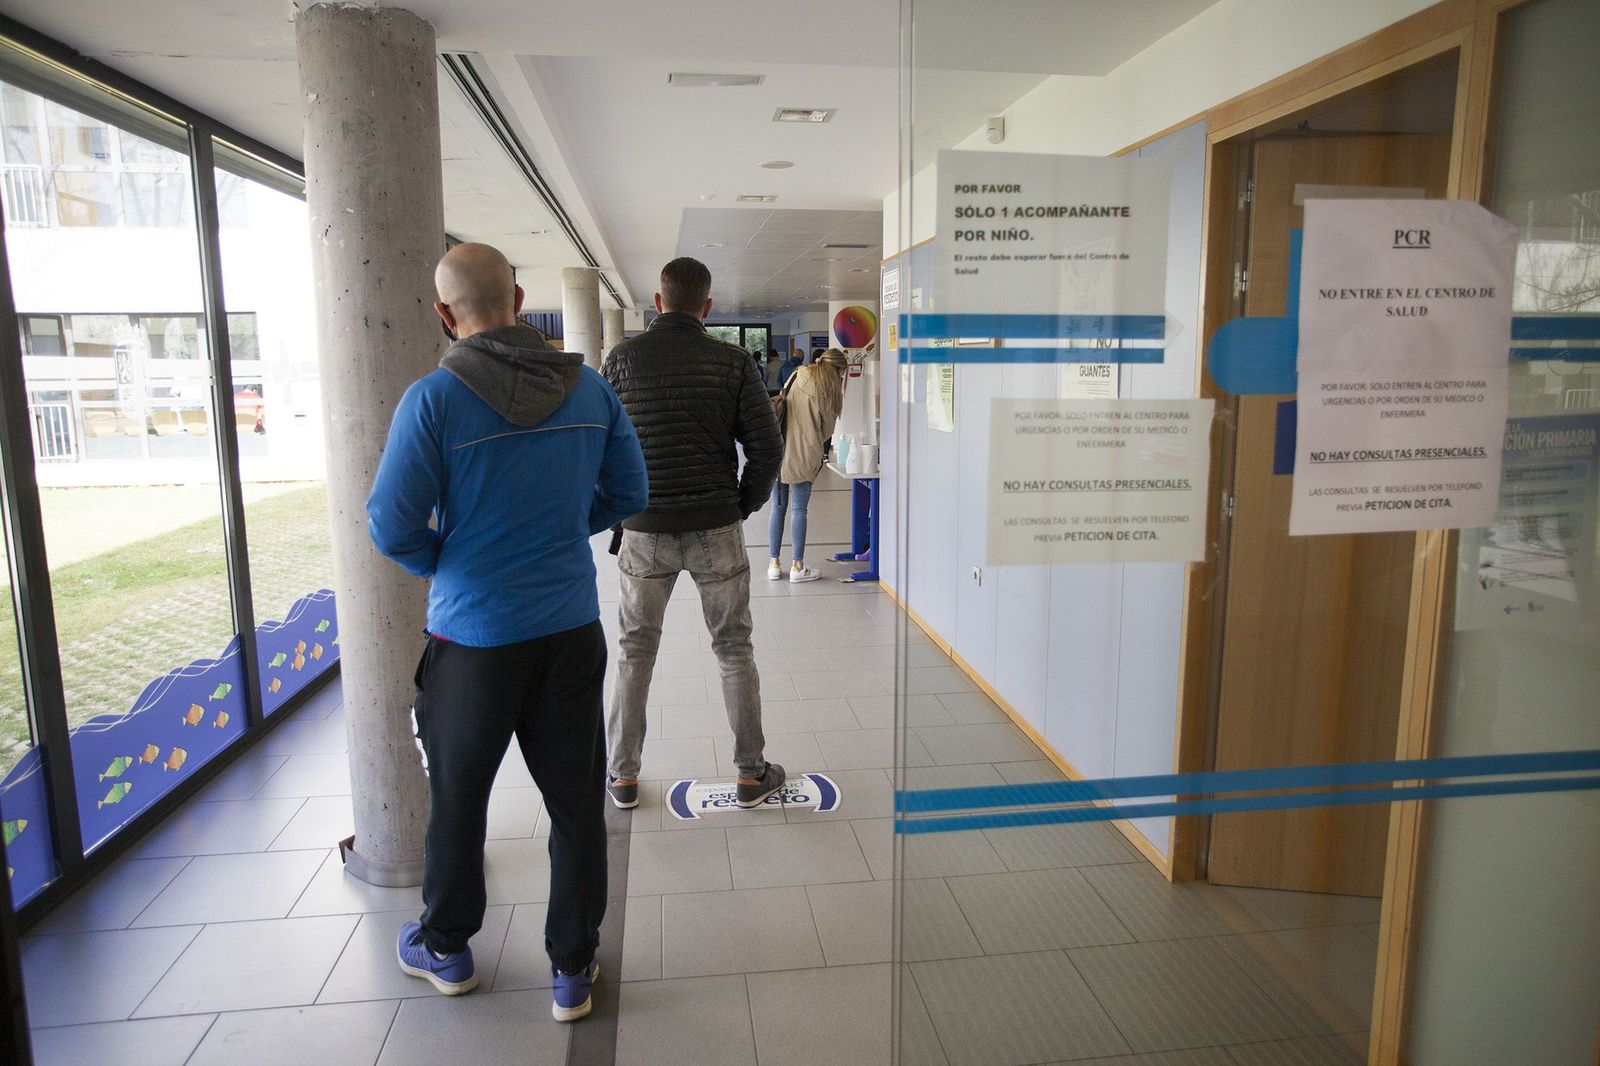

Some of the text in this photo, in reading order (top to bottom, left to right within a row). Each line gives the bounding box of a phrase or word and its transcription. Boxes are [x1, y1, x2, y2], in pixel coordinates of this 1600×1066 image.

[955, 185, 1021, 193] POR FAVOR
[955, 204, 1130, 218] SÓLO 1 ACOMPAÑANTE
[955, 228, 1034, 242] POR NIÑO.
[1394, 230, 1430, 246] PCR
[990, 253, 1011, 261] debe
[1014, 254, 1046, 263] esperar
[1119, 252, 1130, 260] de
[1318, 288, 1495, 299] NO ENTRE EN EL CENTRO DE
[1386, 306, 1428, 317] SALUD
[1079, 365, 1110, 377] GUANTES
[1321, 383, 1337, 391] POR
[1370, 382, 1390, 390] SOLO
[1392, 382, 1420, 390] ENTREN
[1434, 381, 1464, 389] CENTRO
[1466, 381, 1486, 389] PARA
[1322, 397, 1366, 406] URGENCIAS
[1368, 397, 1374, 405] O
[1376, 396, 1392, 404] POR
[1394, 396, 1420, 404] ORDEN
[1434, 395, 1443, 403] SU
[1445, 395, 1475, 403] MEDICO
[1380, 410, 1425, 419] ENFERMERA
[1015, 426, 1062, 434] URGENCIAS
[1063, 426, 1070, 434] O
[1072, 426, 1089, 434] POR
[1091, 426, 1120, 434] ORDEN
[1122, 426, 1132, 434] DE
[1134, 426, 1145, 434] SU
[1147, 426, 1179, 434] MEDICO
[1077, 440, 1126, 448] ENFERMERA
[1538, 429, 1596, 448] PRIMARIA
[1310, 447, 1487, 461] NO HAY CONSULTAS PRESENCIALES.
[1004, 479, 1191, 490] NO HAY CONSULTAS PRESENCIALES.
[1309, 483, 1481, 496] LAS CONSULTAS SE RESUELVEN POR TELEFONO
[1337, 499, 1452, 511] PREVIA PETICION DE CITA.
[1004, 518, 1019, 526] LAS
[1020, 517, 1066, 525] CONSULTAS
[1084, 516, 1129, 524] RESUELVEN
[1034, 531, 1159, 542] PREVIA PETICION DE CITA.
